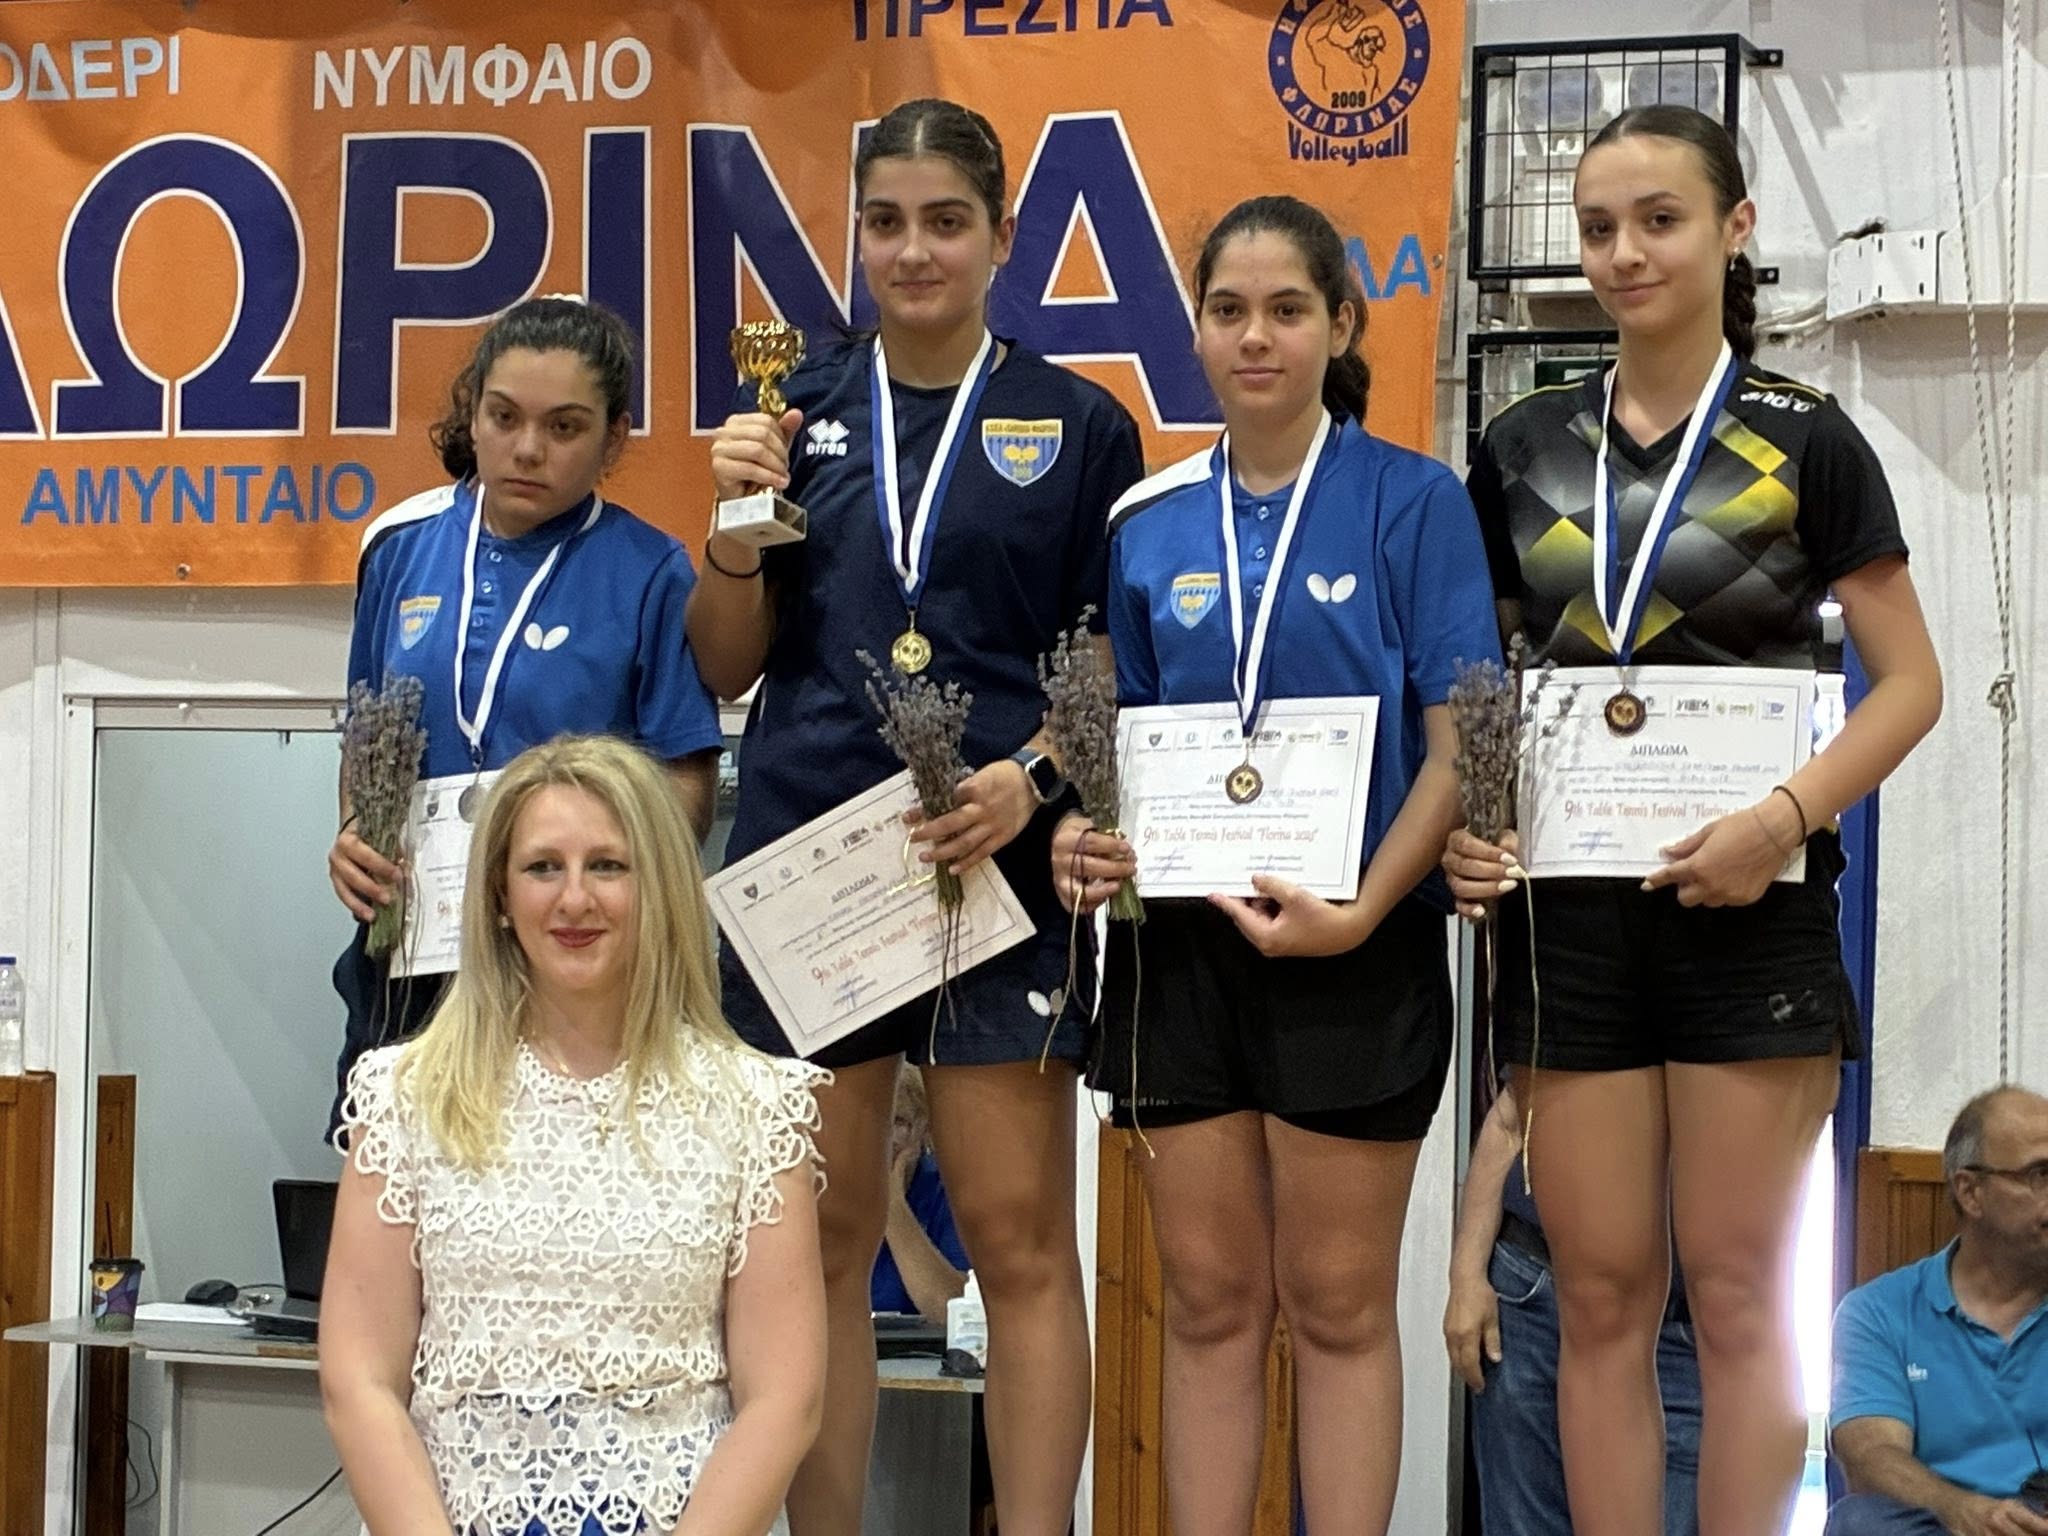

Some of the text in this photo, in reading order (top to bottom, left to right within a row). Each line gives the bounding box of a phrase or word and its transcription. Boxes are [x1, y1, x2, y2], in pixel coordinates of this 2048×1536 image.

[313, 36, 653, 110] ΝΥΜΦΑΙΟ
[1331, 91, 1367, 108] 2009
[1288, 114, 1410, 167] Volleyball
[0, 109, 1228, 441] ΩΡΙΝΑ
[21, 462, 376, 525] ΑΜΥΝΤΑΙΟ
[1630, 744, 1689, 757] ΔΙΠΛΩΜΑ
[1587, 801, 1614, 817] Table
[1616, 802, 1648, 817] Tennis
